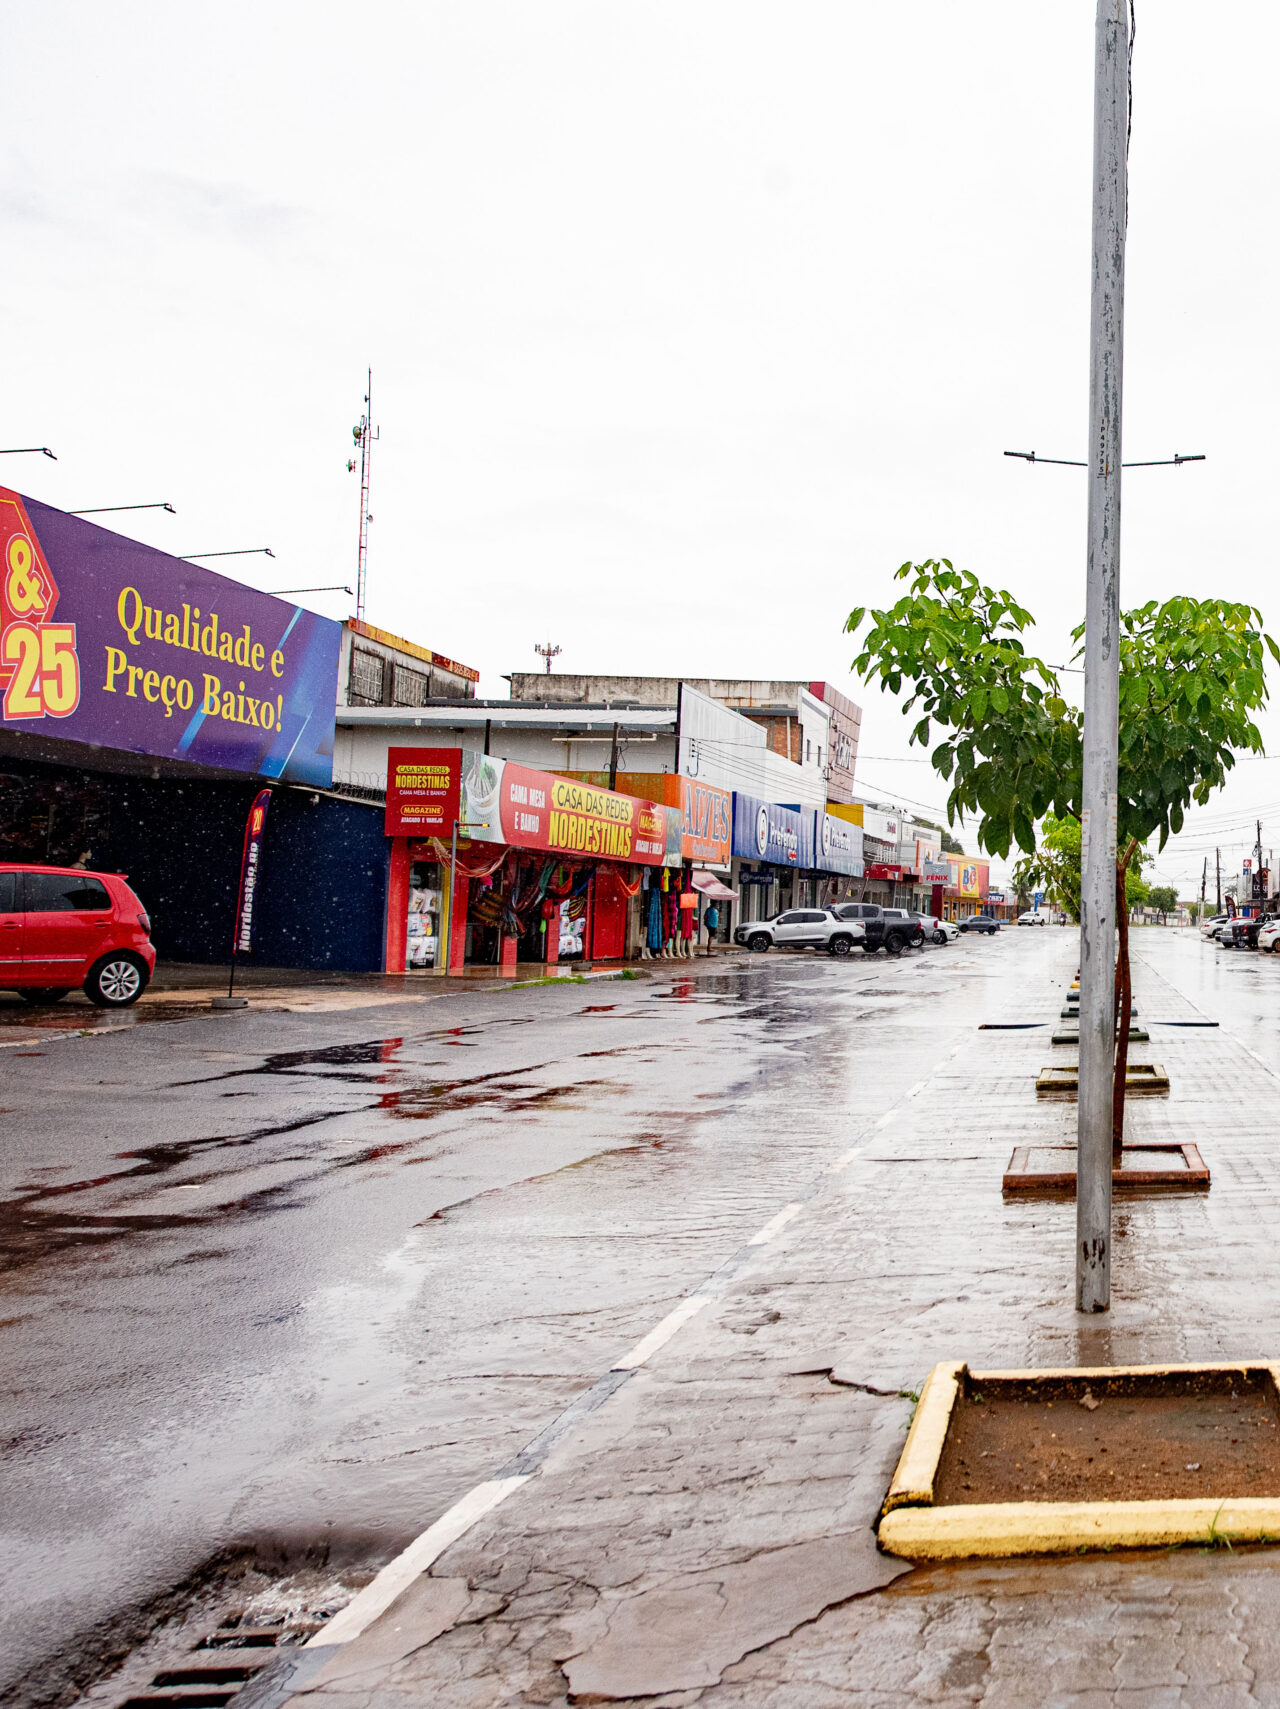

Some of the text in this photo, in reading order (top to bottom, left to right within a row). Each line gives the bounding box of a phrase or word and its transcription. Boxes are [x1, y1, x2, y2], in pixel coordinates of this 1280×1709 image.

[117, 586, 285, 678] Qualidade e
[4, 626, 79, 716] 25
[102, 645, 284, 733] Preço Baixo!
[395, 774, 450, 789] NORDESTINAS
[416, 766, 428, 774] DAS
[429, 766, 447, 774] REDES
[403, 806, 441, 814] MAGAZINE
[510, 783, 546, 809] CAMA MESA
[557, 785, 629, 821] CASA DAS REDES
[514, 811, 540, 833] E BANHO
[681, 783, 730, 843] ALVES
[548, 810, 632, 858] NORDESTINAS
[925, 873, 948, 881] FÊNIX
